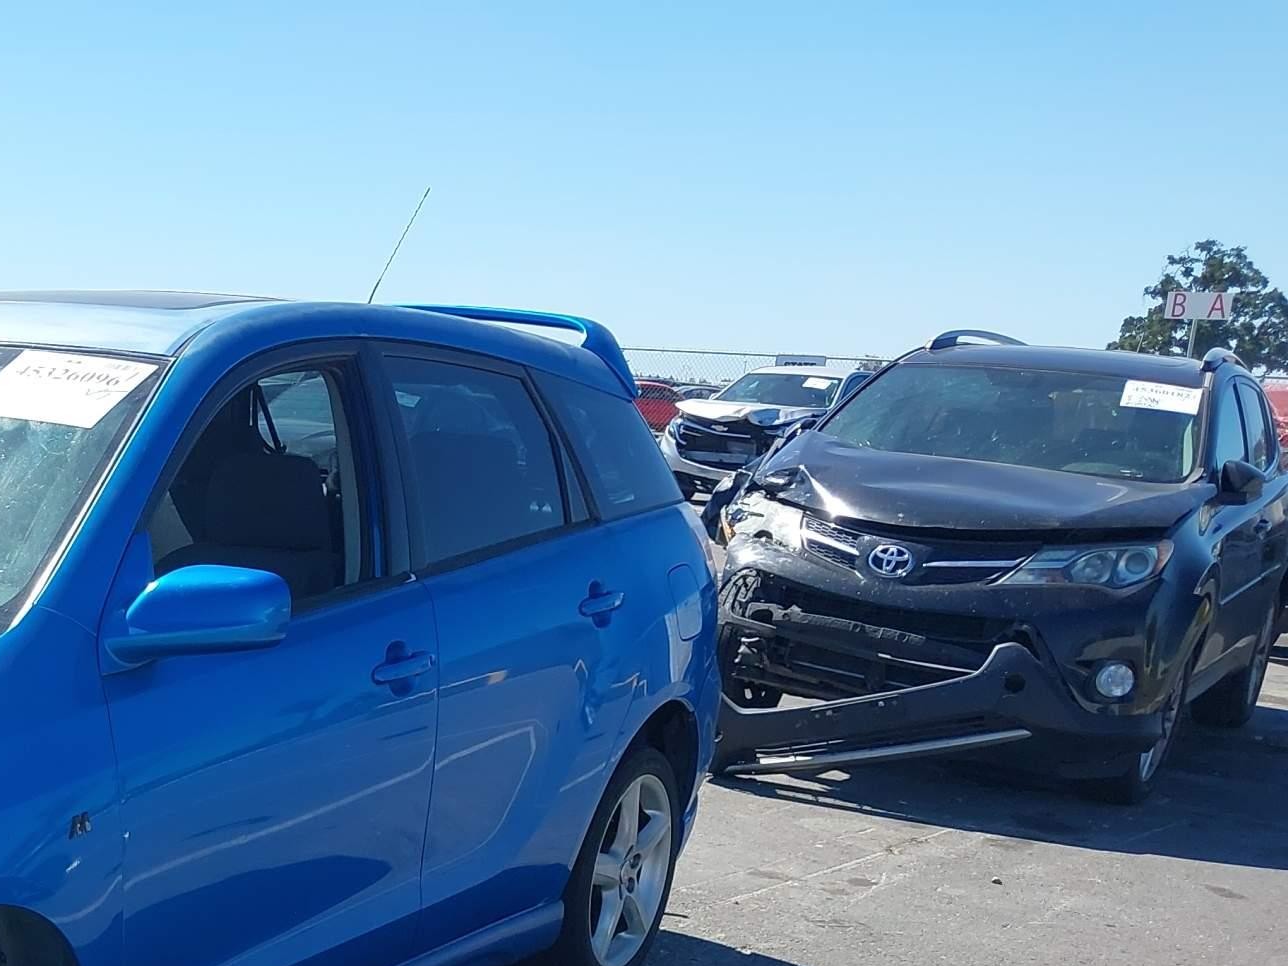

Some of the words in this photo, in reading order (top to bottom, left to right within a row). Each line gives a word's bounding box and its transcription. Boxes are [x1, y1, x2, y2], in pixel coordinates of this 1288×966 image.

[1171, 293, 1187, 318] B
[1206, 293, 1225, 318] A
[16, 365, 121, 387] 45326096
